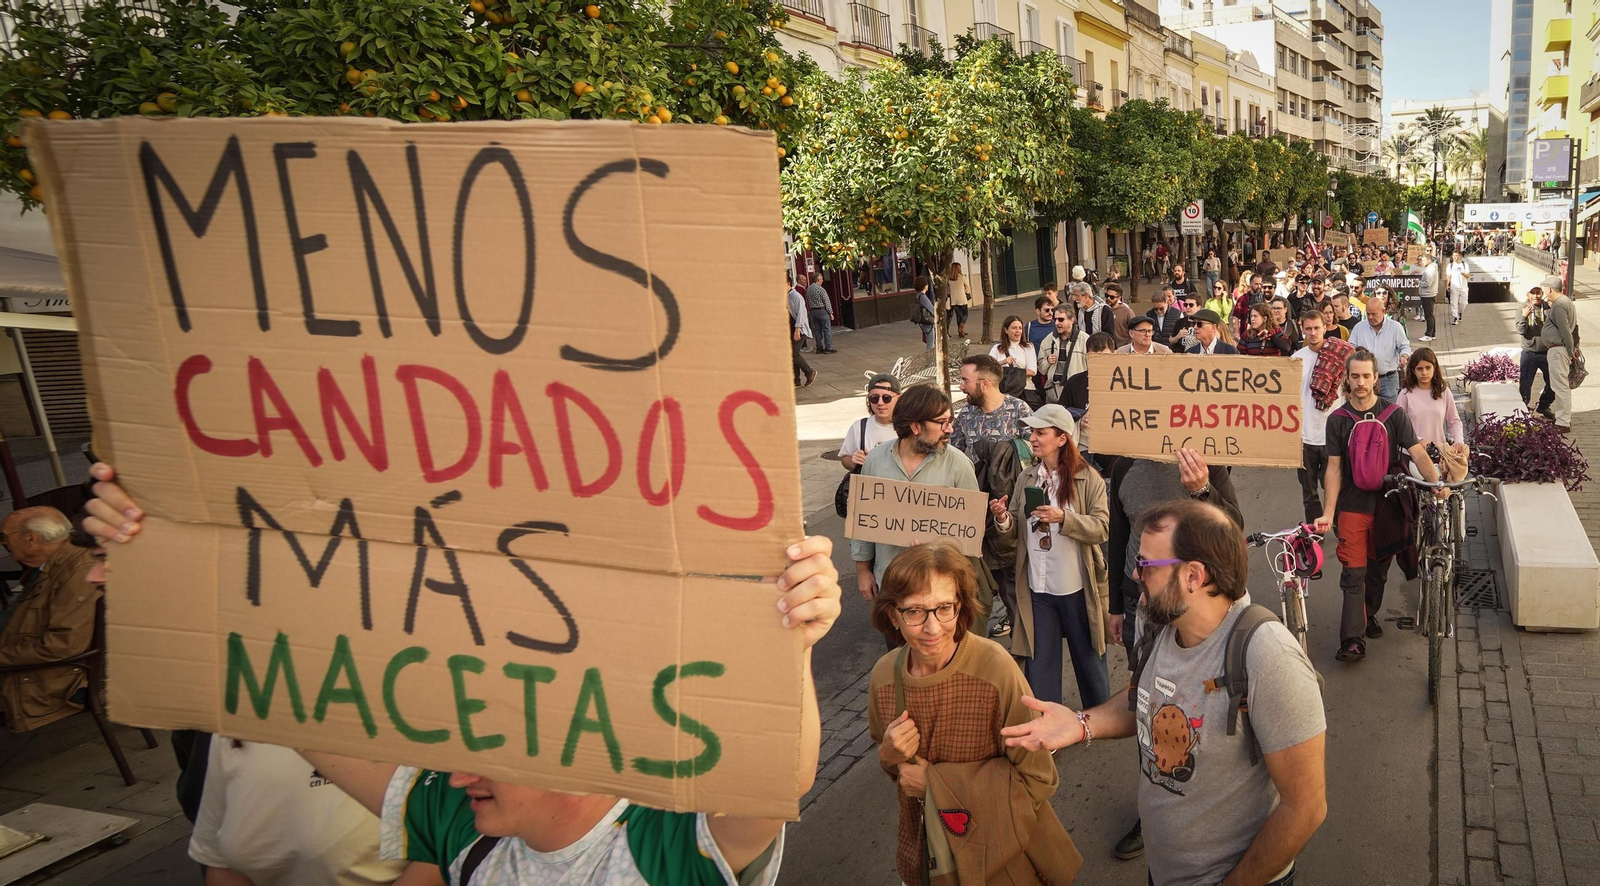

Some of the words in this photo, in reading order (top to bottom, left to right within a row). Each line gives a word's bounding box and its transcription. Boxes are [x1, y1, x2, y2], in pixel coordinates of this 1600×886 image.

[1536, 141, 1551, 160] P
[138, 134, 681, 372] MENOS
[1109, 365, 1163, 392] ALL
[1178, 367, 1283, 394] CASEROS
[1111, 408, 1161, 432] ARE
[1169, 403, 1300, 433] BASTARDS
[174, 353, 780, 531] CANDADOS
[859, 482, 886, 501] LA
[857, 513, 879, 529] ES
[885, 517, 905, 532] UN
[911, 518, 977, 539] DERECHO
[234, 486, 581, 655] MÁS
[223, 629, 727, 780] MACETAS
